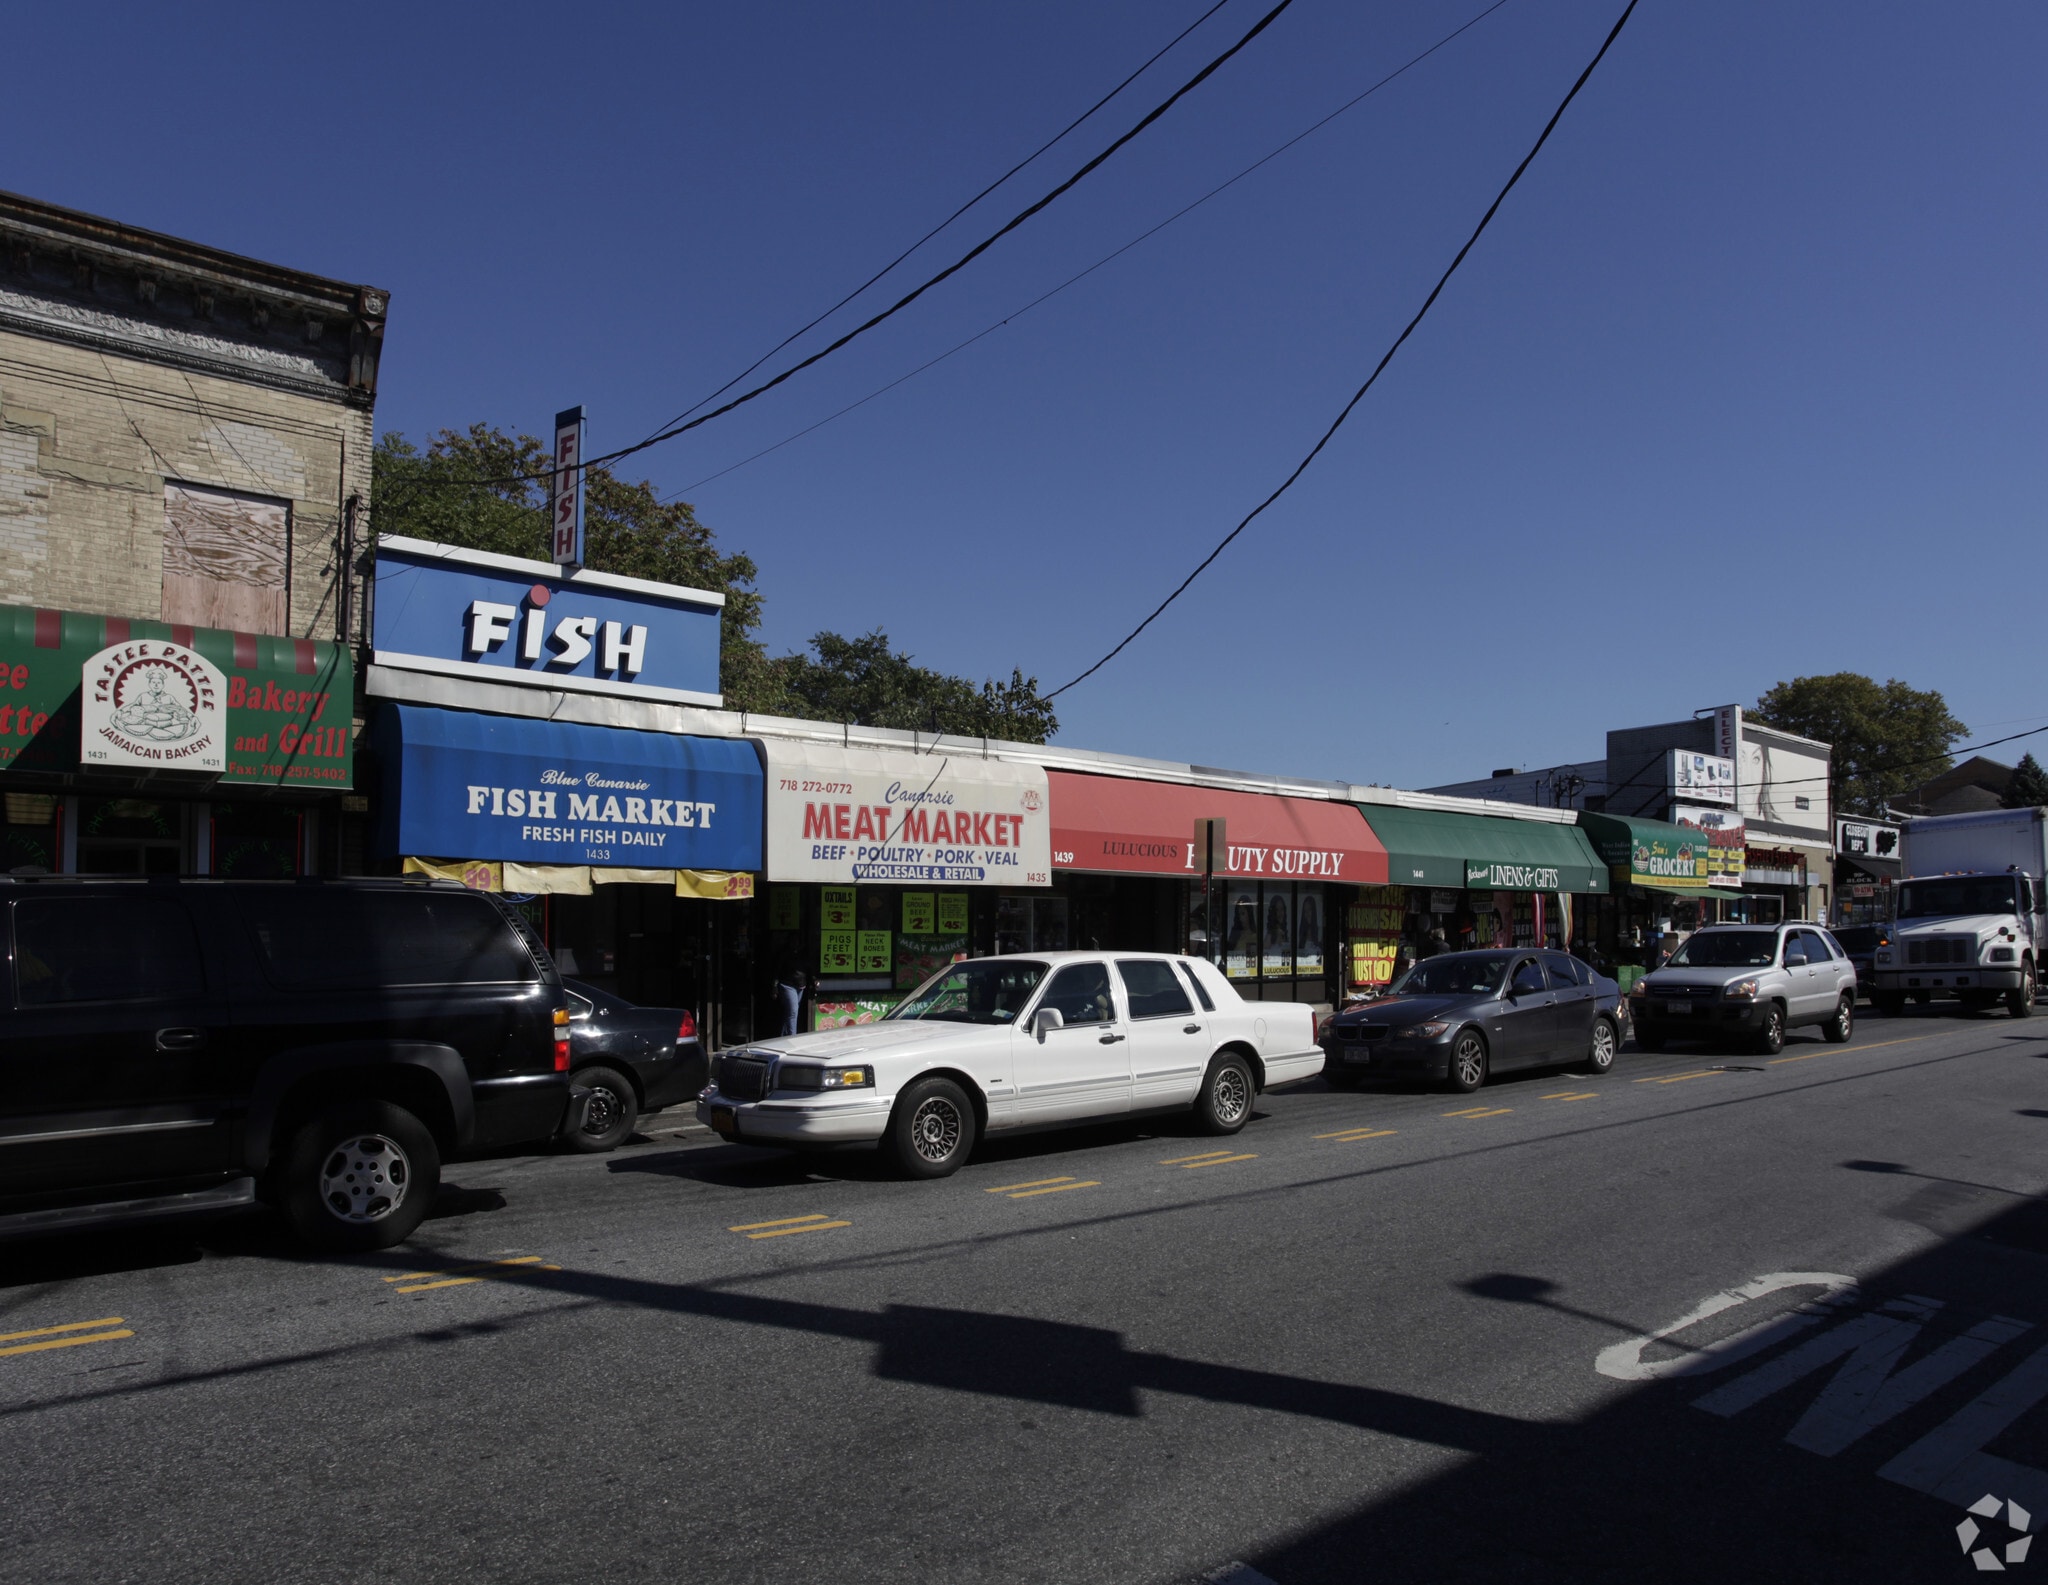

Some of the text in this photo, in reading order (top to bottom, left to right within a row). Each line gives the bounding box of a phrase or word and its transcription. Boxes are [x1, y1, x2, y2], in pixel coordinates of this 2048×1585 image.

[556, 432, 578, 557] FISH
[95, 643, 215, 712] TASTEE PATTEE
[228, 676, 331, 721] Bakery
[98, 726, 213, 761] JAMAICAN BAKERY
[234, 724, 348, 758] and Grill
[1721, 710, 1732, 759] ELECT
[87, 750, 108, 760] 1431
[201, 758, 221, 767] 1431
[228, 761, 254, 776] Fax:
[540, 769, 651, 791] Blue Canarsie
[779, 779, 853, 795] 718 272-0772
[884, 781, 955, 805] Canarsie
[467, 785, 716, 829] FISH MARKET
[801, 801, 1024, 848] MEAT MARKET
[522, 826, 667, 847] FRESH FISH DAILY
[585, 848, 611, 860] 1433
[811, 845, 1019, 866] BEEF POULTRY PORK VEAL
[1054, 851, 1074, 863] 1439
[1103, 841, 1344, 876] LULUCIOUS BUTY SUPPLY
[856, 864, 982, 881] WHOLESALE & RETAIL
[1026, 872, 1047, 883] 1435
[1413, 869, 1424, 878] 1441
[1490, 864, 1524, 886] LINENS
[1524, 867, 1535, 887] &
[1535, 868, 1558, 888] GIFTS
[1650, 857, 1695, 877] GROCERY
[825, 891, 853, 903] OXTAILS
[512, 904, 543, 925] ISH
[1379, 908, 1404, 930] SAL
[827, 944, 850, 953] FEET
[829, 935, 852, 944] PIGS
